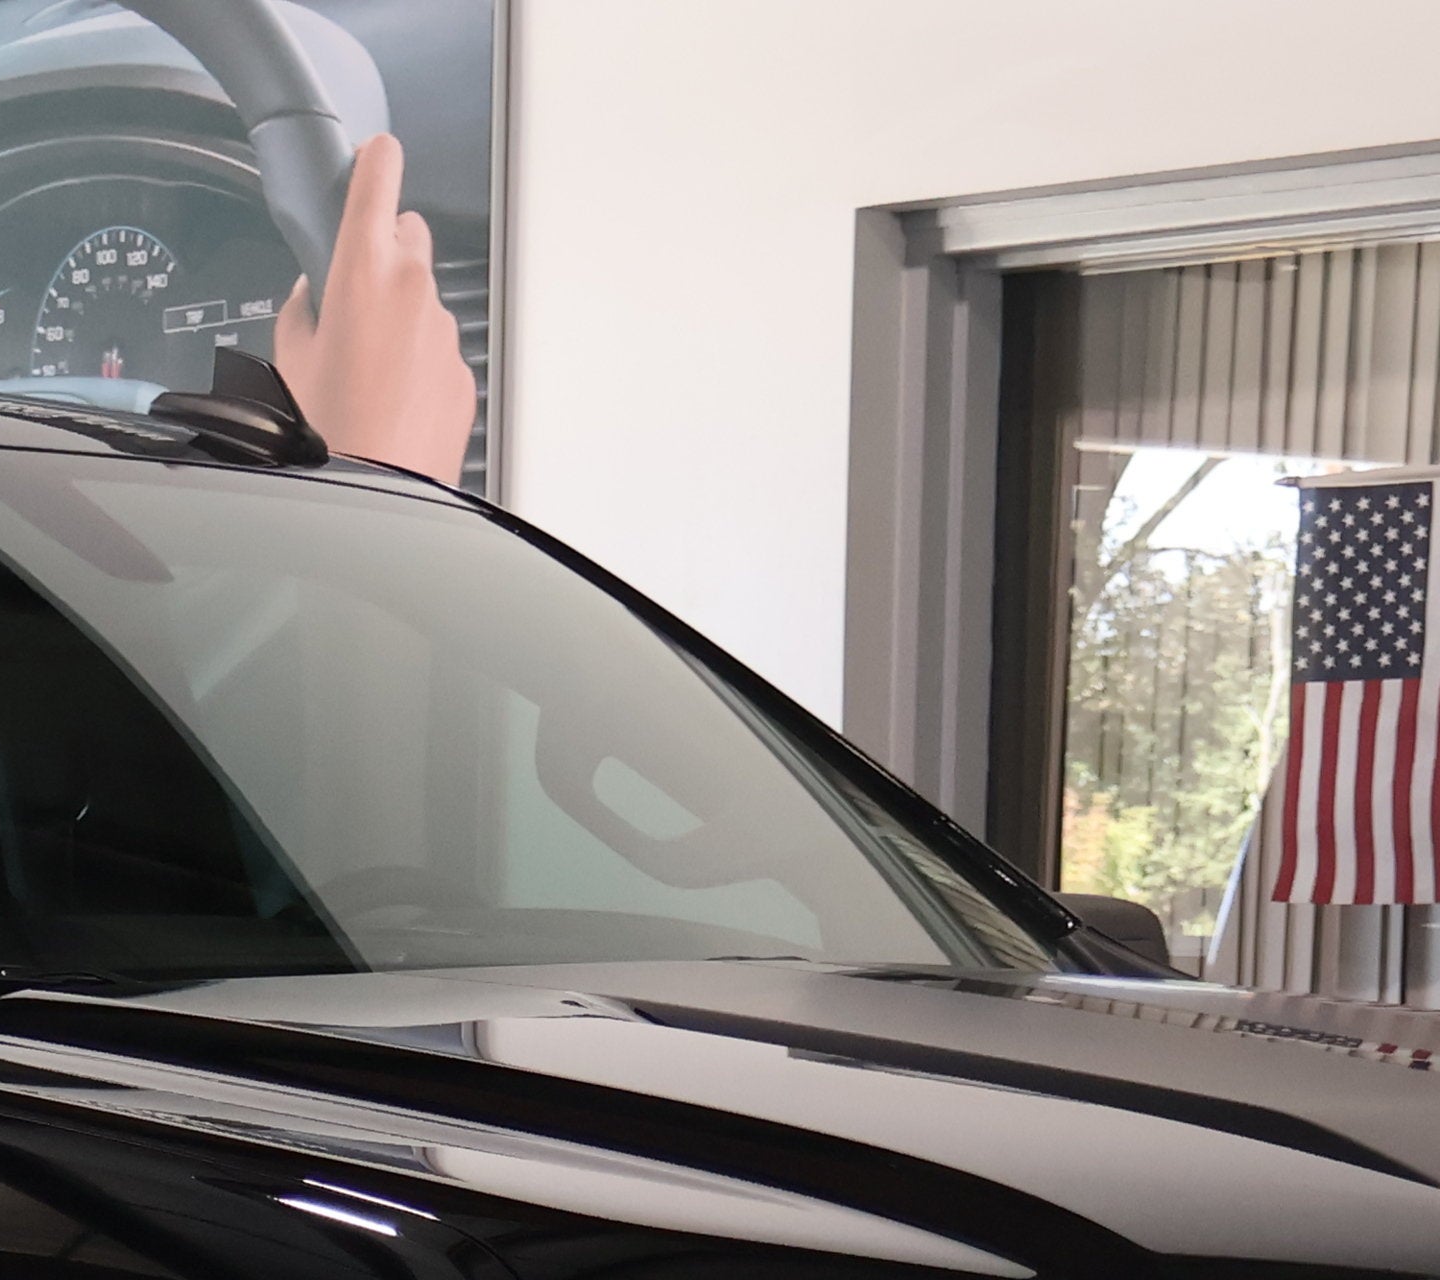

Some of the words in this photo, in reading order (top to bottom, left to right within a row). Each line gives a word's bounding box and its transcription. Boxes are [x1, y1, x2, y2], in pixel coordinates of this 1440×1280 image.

[96, 249, 117, 265] 100
[126, 251, 148, 266] 120
[146, 273, 168, 290] 140
